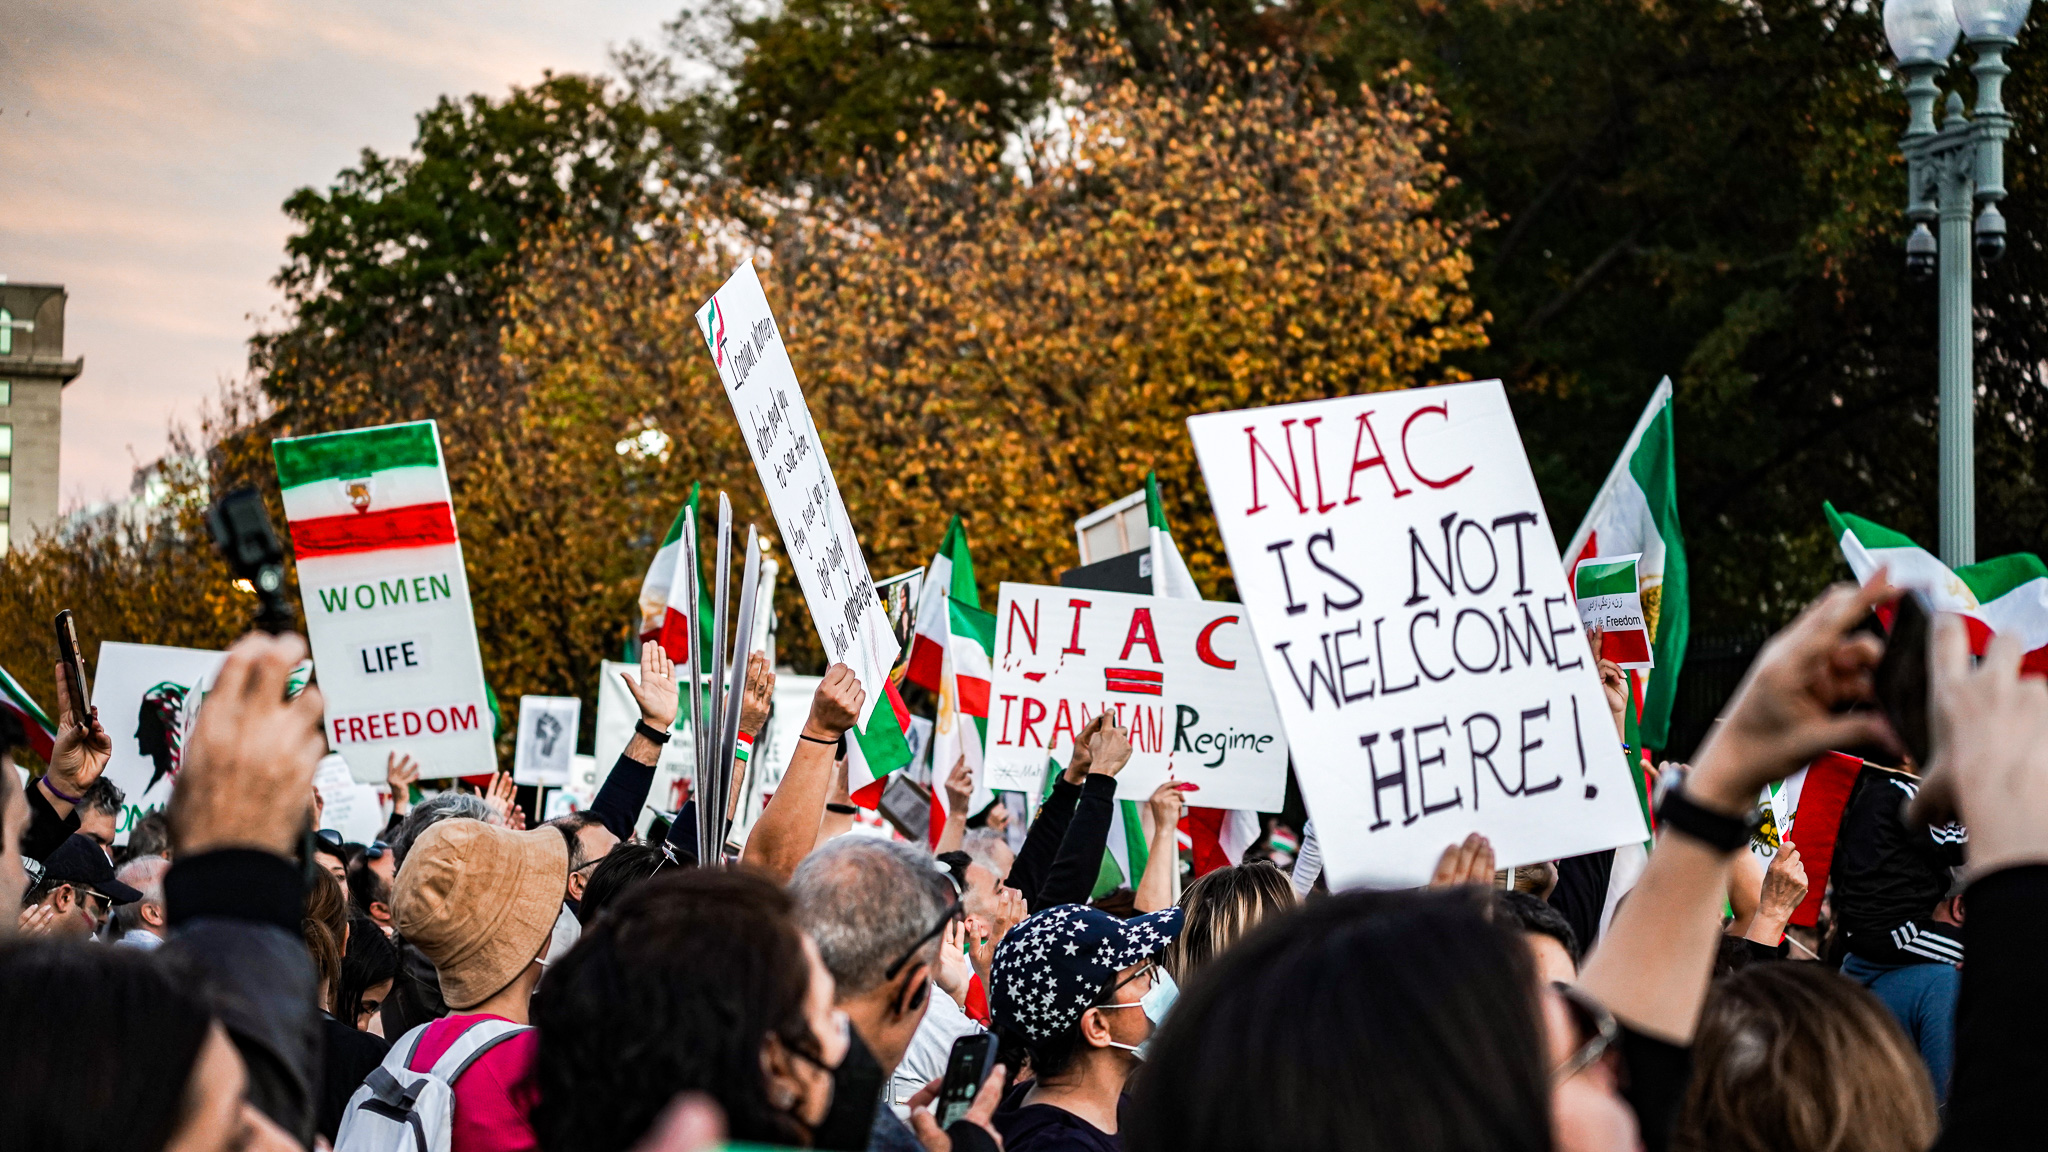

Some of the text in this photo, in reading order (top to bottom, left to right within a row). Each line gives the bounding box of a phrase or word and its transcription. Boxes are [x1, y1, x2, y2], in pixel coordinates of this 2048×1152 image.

[720, 337, 758, 390] Iranian
[767, 387, 783, 439] need
[776, 389, 793, 435] you
[774, 463, 787, 489] to
[783, 447, 798, 473] save
[1243, 400, 1474, 515] NIAC
[788, 470, 830, 560] they need you to
[826, 533, 850, 576] saving
[1266, 512, 1537, 616] IS NOT
[318, 573, 451, 613] WOMEN
[830, 623, 849, 663] their
[1007, 598, 1240, 670] NIAC
[1606, 614, 1641, 627] Freedom
[361, 641, 418, 674] LIFE
[1274, 593, 1584, 712] WELCOME
[333, 704, 478, 743] FREEDOM
[1173, 704, 1274, 769] Regime
[1359, 695, 1597, 832] HERE!
